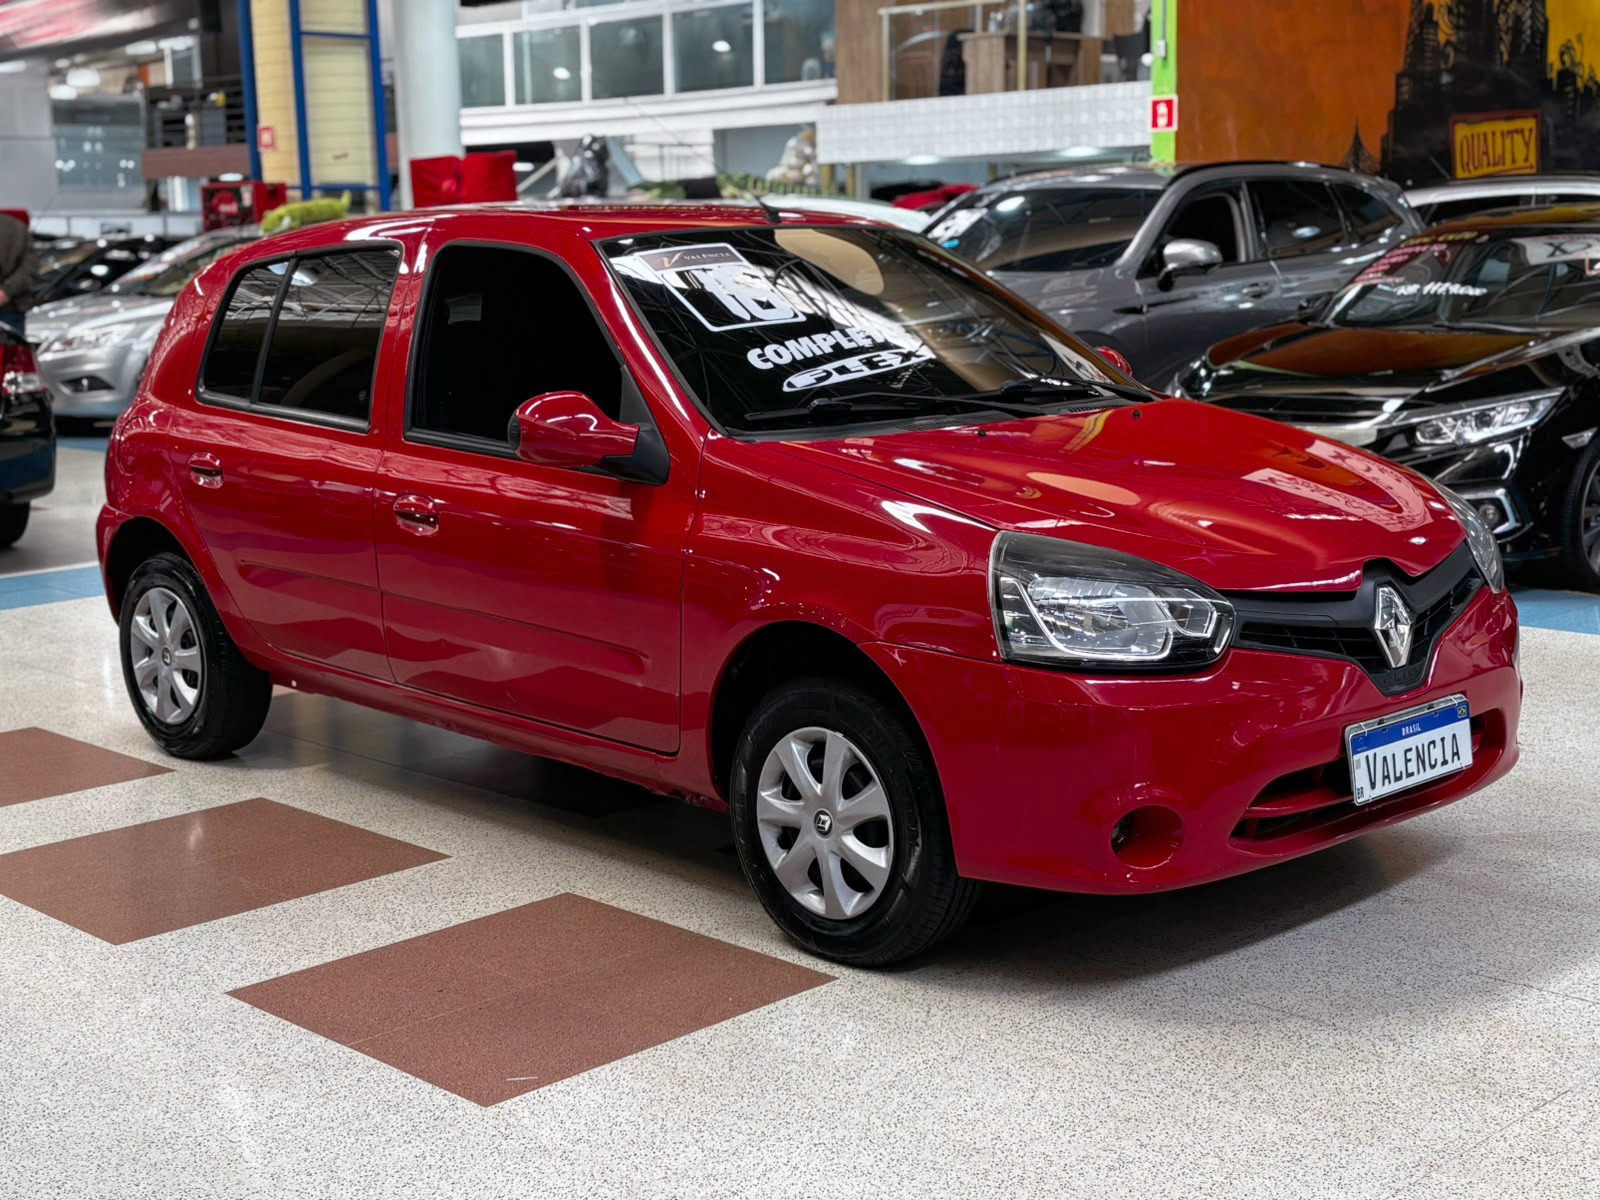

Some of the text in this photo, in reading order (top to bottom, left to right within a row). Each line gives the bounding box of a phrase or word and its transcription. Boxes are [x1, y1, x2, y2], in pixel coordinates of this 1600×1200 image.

[1460, 128, 1533, 175] QUALITY
[785, 348, 929, 391] FLEX
[1402, 722, 1421, 736] BRASIL
[1365, 733, 1461, 791] VALENCIA
